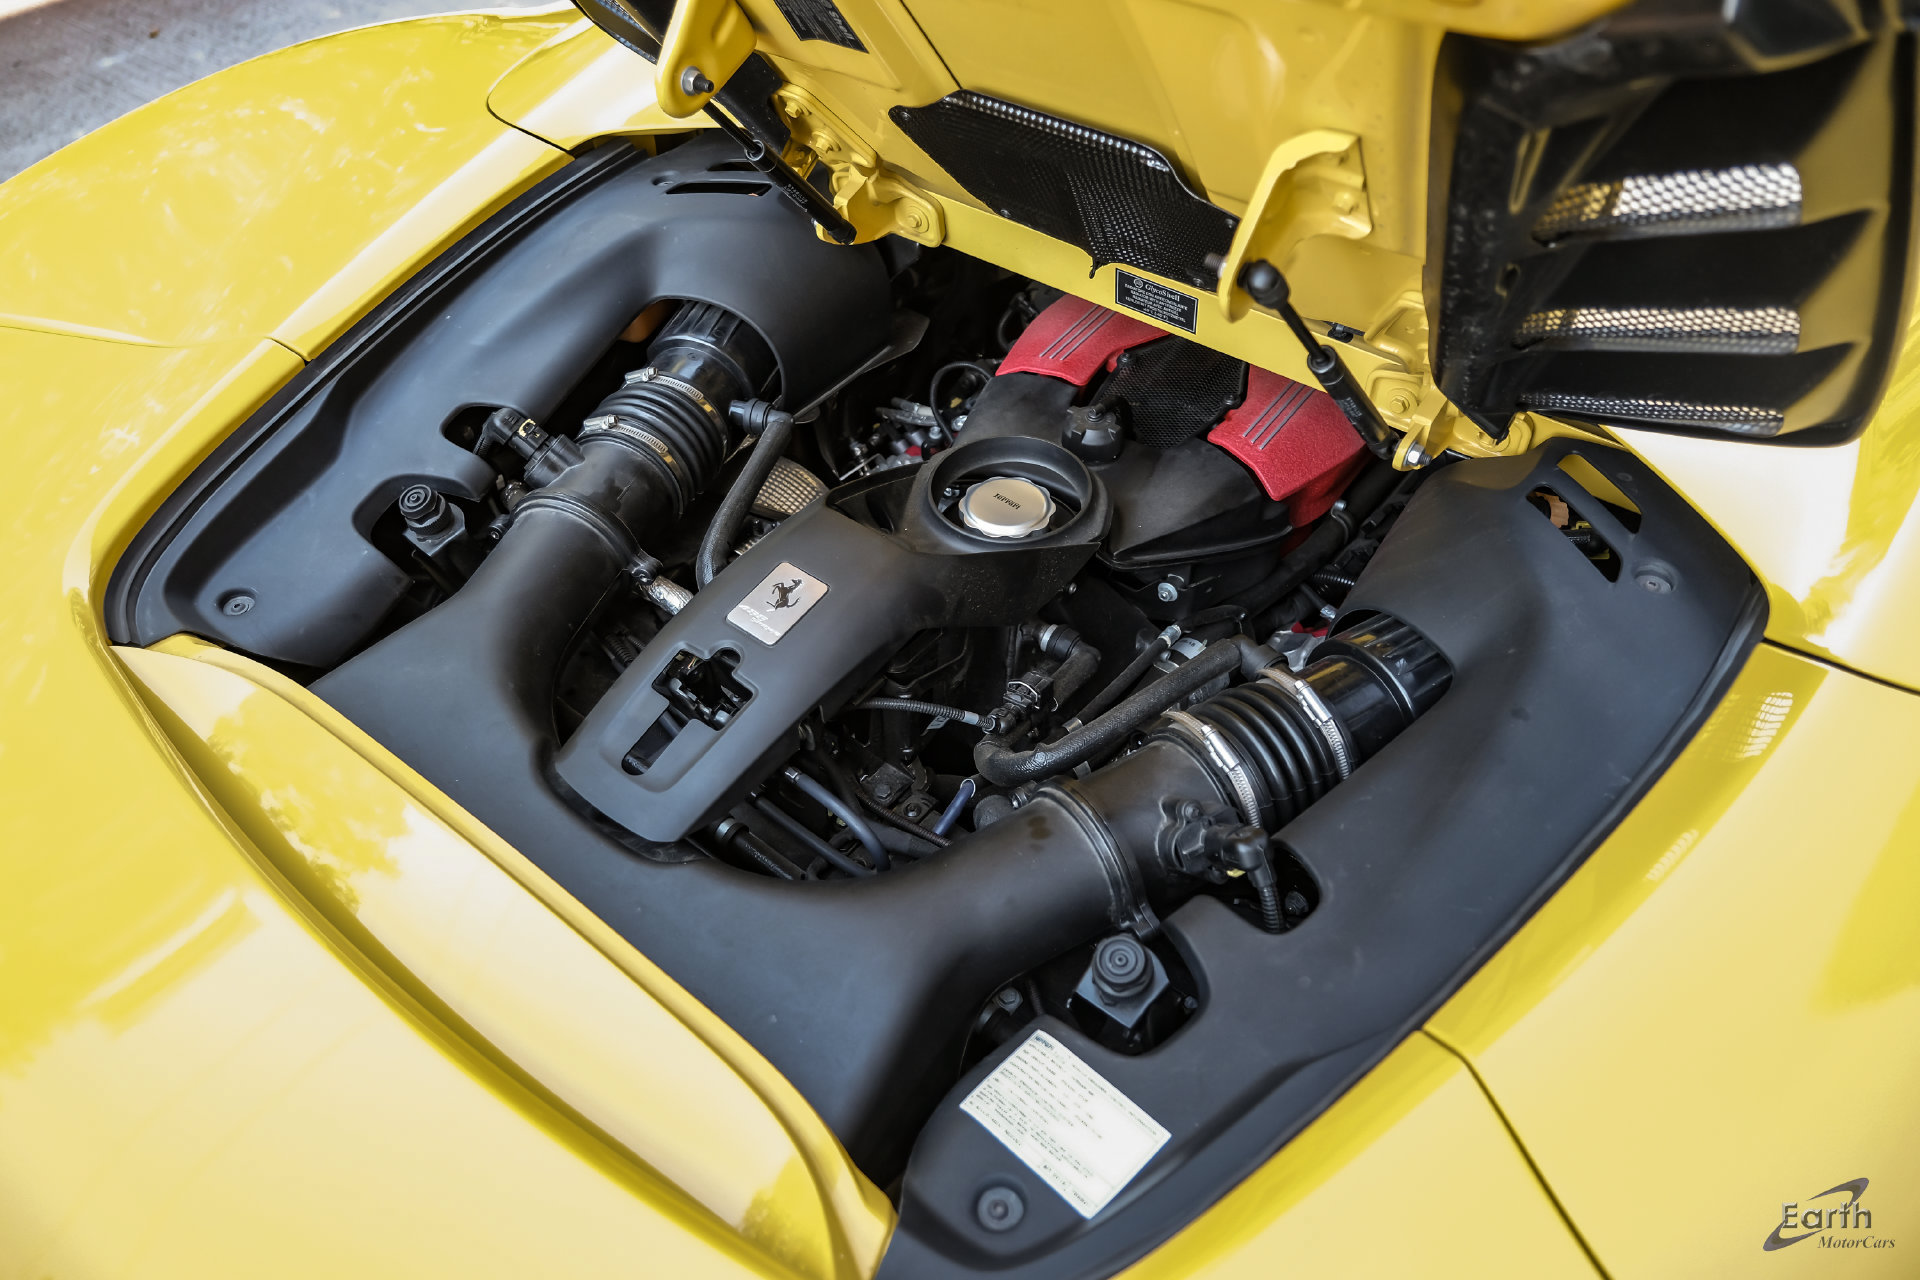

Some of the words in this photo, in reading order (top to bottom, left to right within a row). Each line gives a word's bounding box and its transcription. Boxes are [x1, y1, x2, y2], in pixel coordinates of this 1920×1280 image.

[829, 10, 855, 40] Shell
[1145, 283, 1180, 302] GlycoShell
[993, 493, 1021, 510] Ferrari
